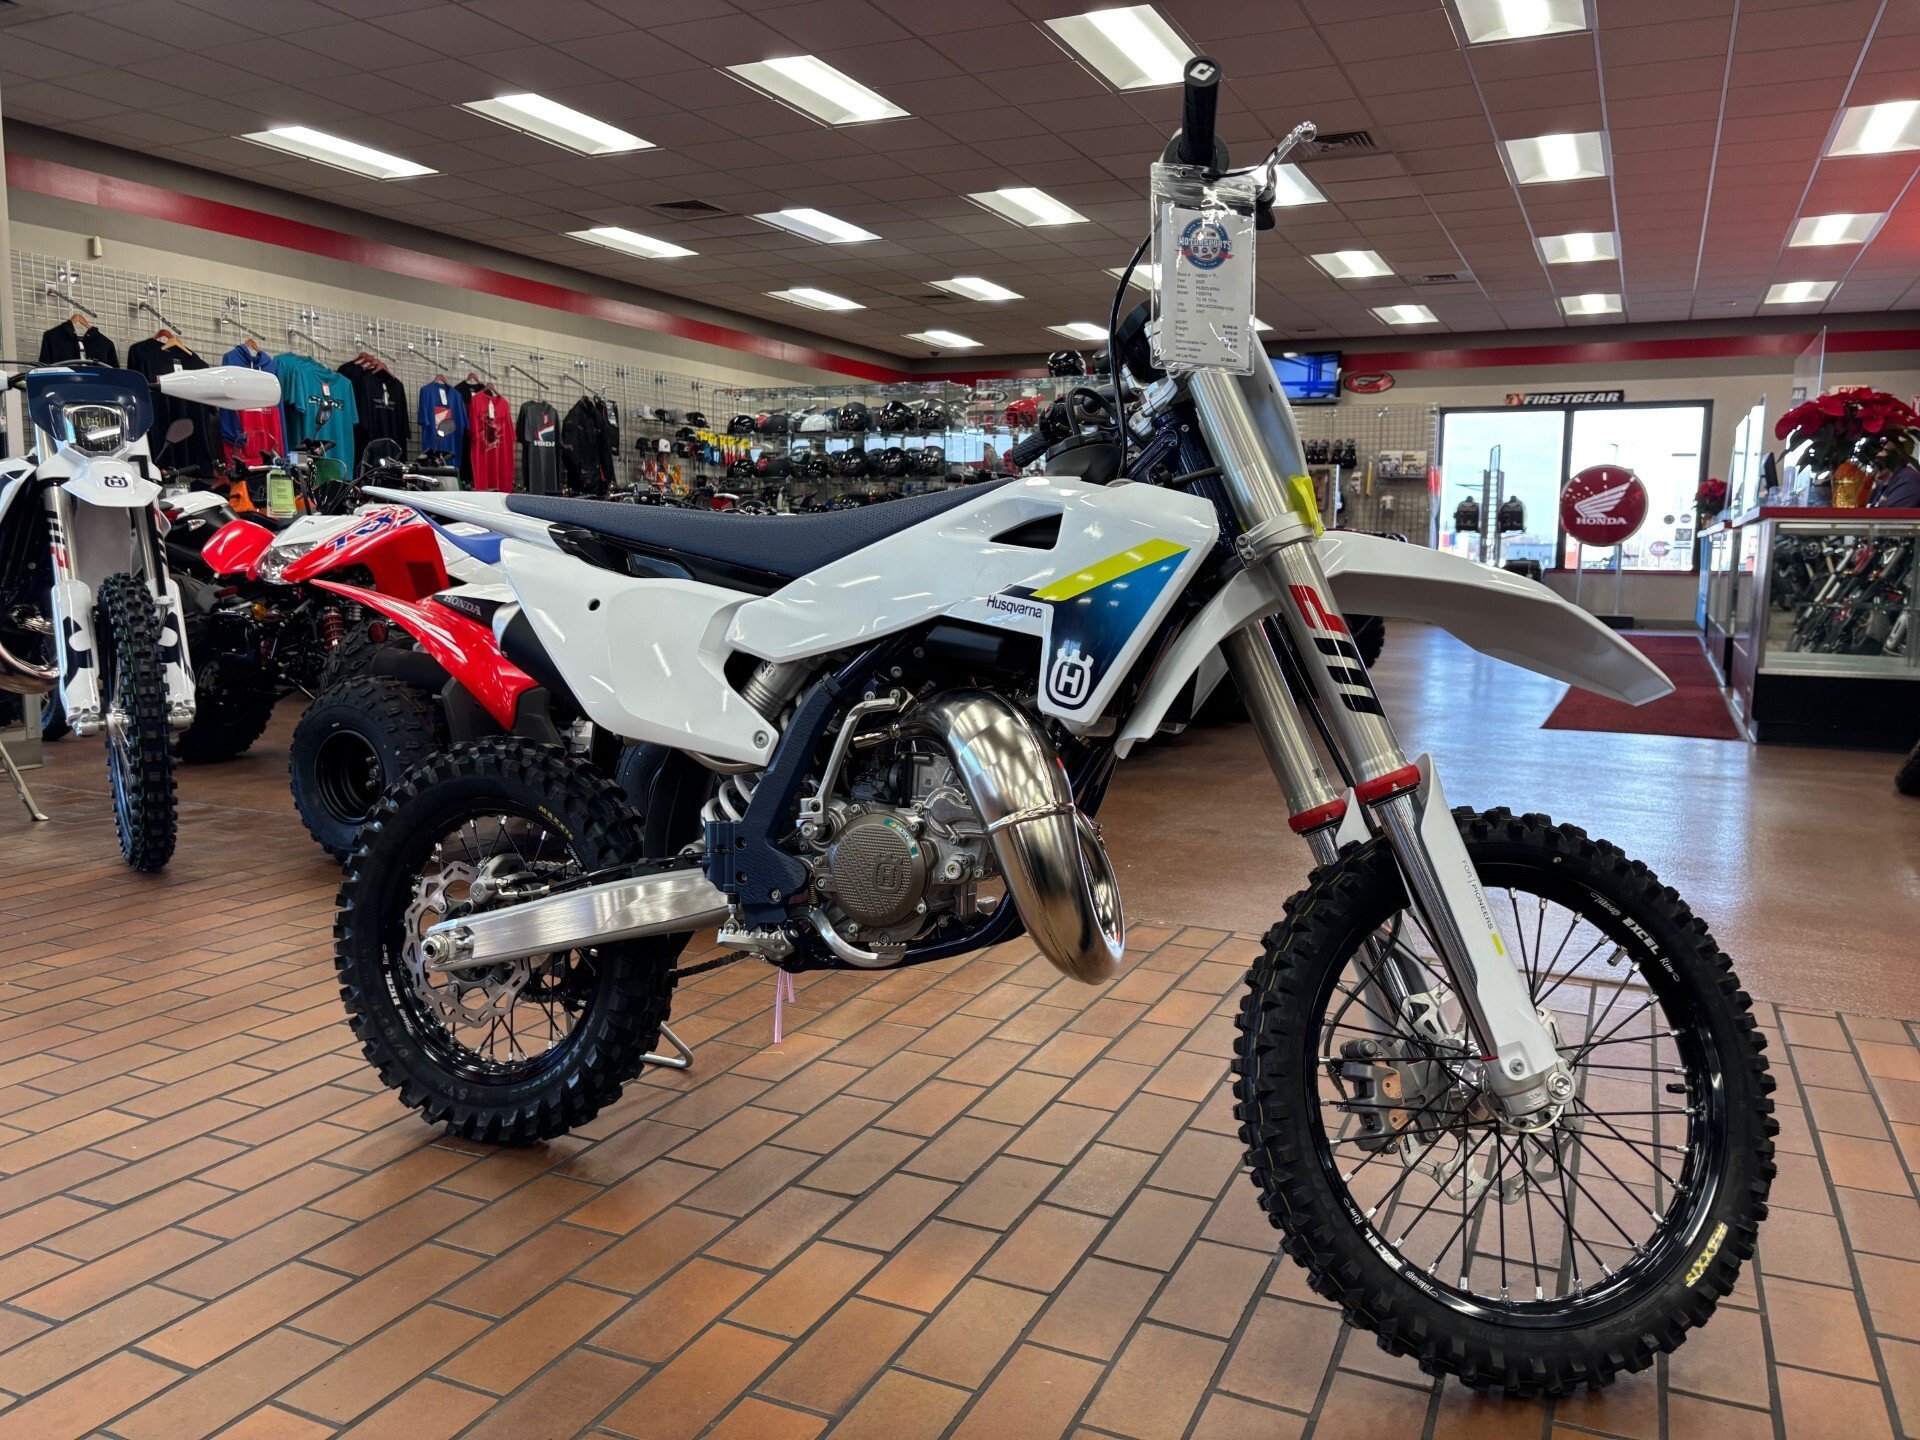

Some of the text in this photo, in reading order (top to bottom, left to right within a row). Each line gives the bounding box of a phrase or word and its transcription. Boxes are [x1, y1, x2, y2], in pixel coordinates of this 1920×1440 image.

[1178, 236, 1232, 251] MOTORSPORTS
[1523, 392, 1620, 405] FIRSTGEAR
[1576, 517, 1628, 525] HONDA
[443, 594, 482, 617] HONDA
[986, 594, 1043, 619] Husqvarna
[1471, 883, 1494, 931] PIONEERS
[1622, 916, 1660, 955] EXCEL
[384, 970, 401, 1006] EXCEL
